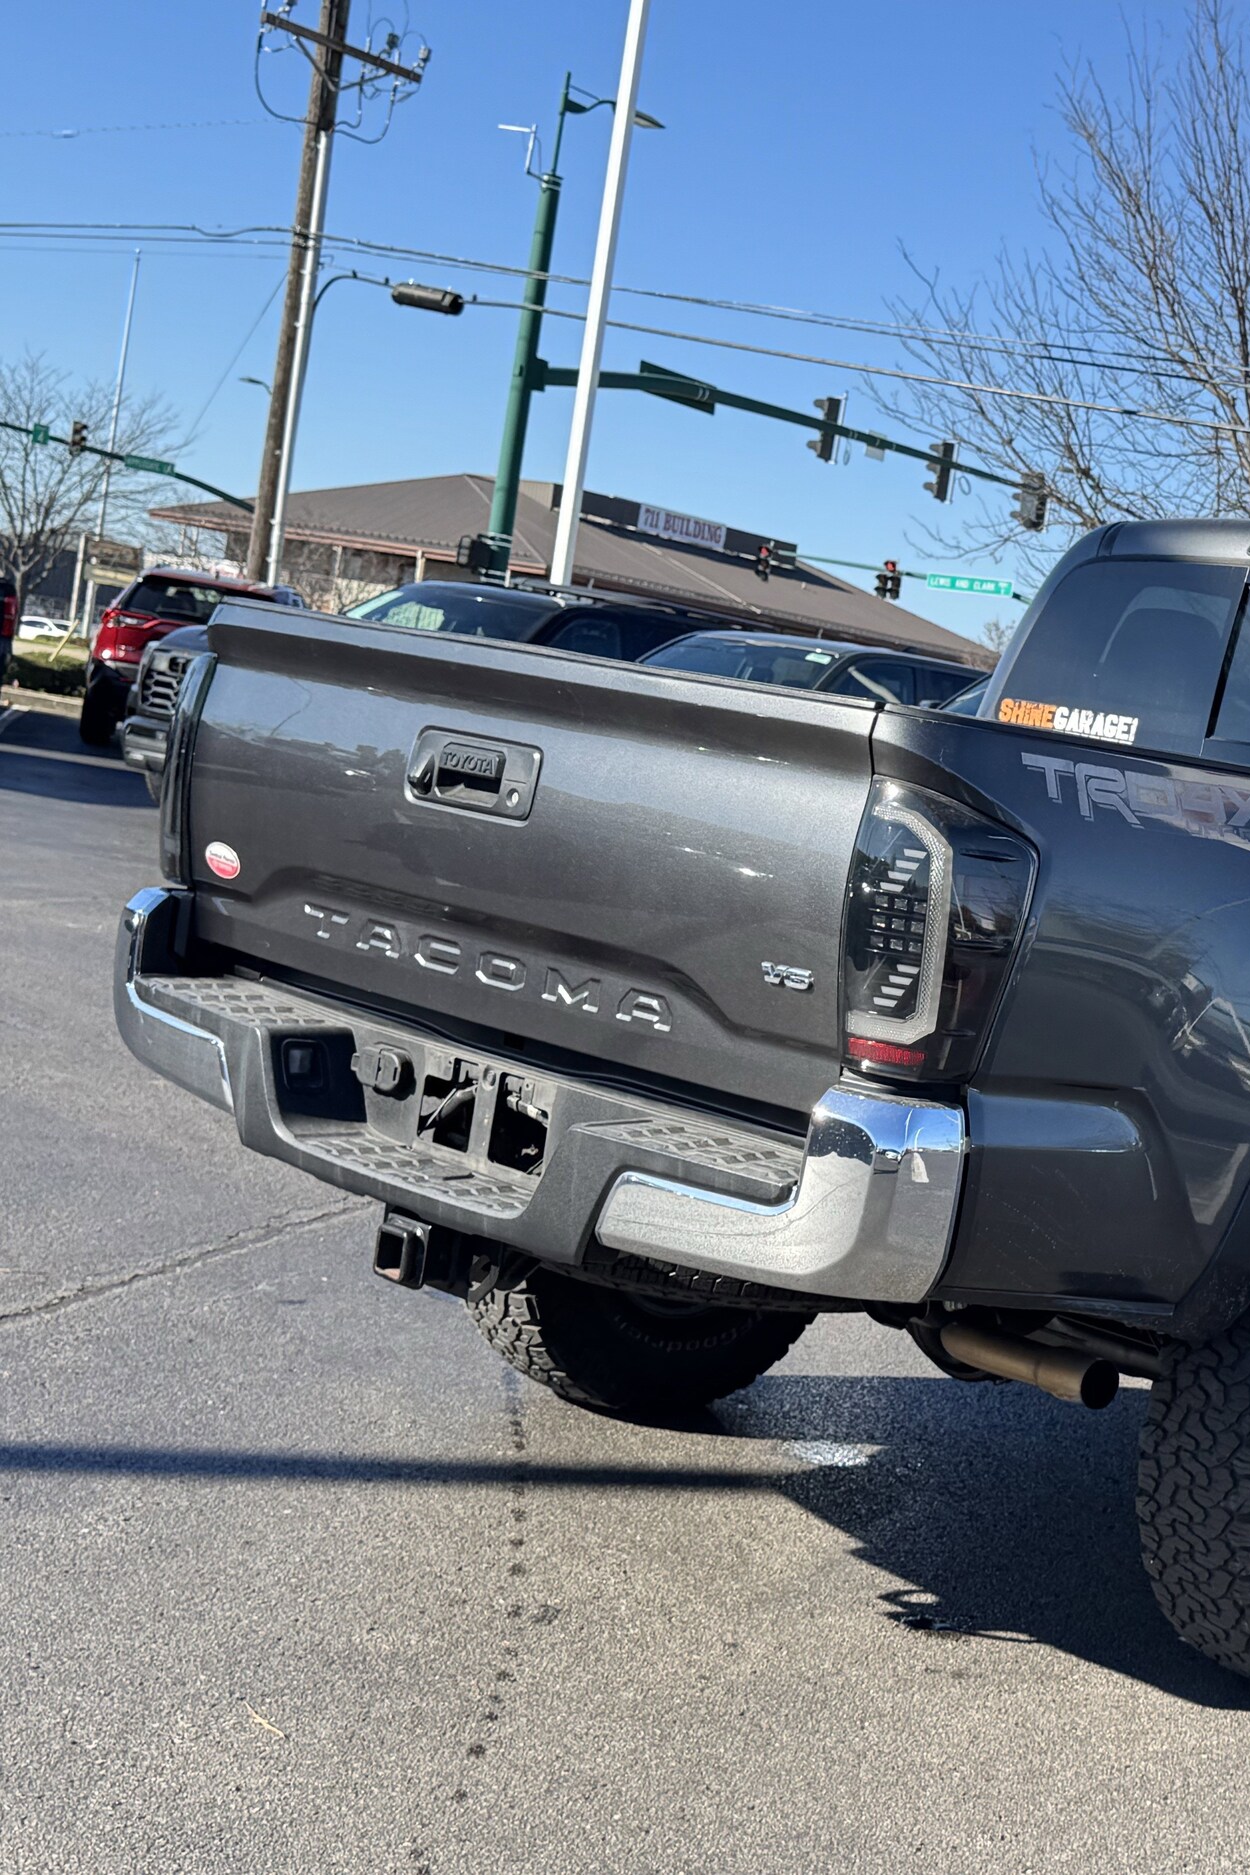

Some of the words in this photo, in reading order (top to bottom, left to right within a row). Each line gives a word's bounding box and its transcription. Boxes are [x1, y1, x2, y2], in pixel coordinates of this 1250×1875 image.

[663, 512, 723, 544] BUILDING
[955, 578, 970, 589] AND
[441, 751, 496, 776] TOYOTA
[303, 902, 673, 1032] TACOMA
[760, 961, 814, 991] V6
